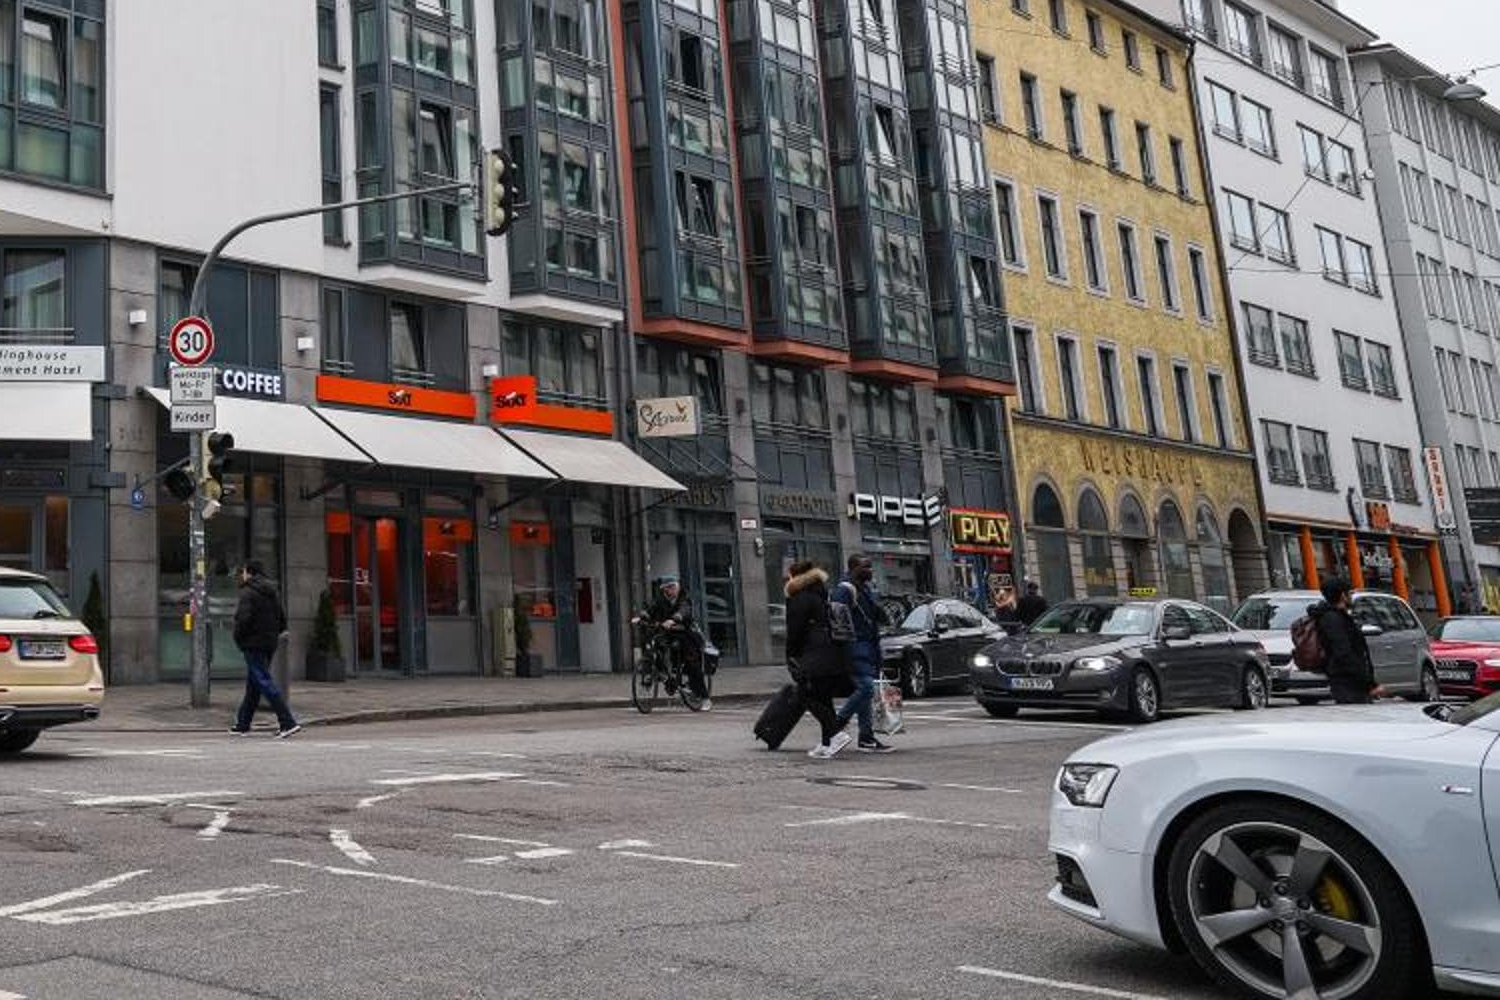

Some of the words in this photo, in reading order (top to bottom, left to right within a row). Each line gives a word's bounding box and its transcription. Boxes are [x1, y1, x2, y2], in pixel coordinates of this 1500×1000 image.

[180, 331, 204, 352] 30
[42, 365, 82, 376] Hotel
[222, 369, 281, 395] COFFEE
[175, 411, 211, 424] Kinder
[855, 493, 941, 526] PIPES
[961, 517, 1010, 543] PLAY
